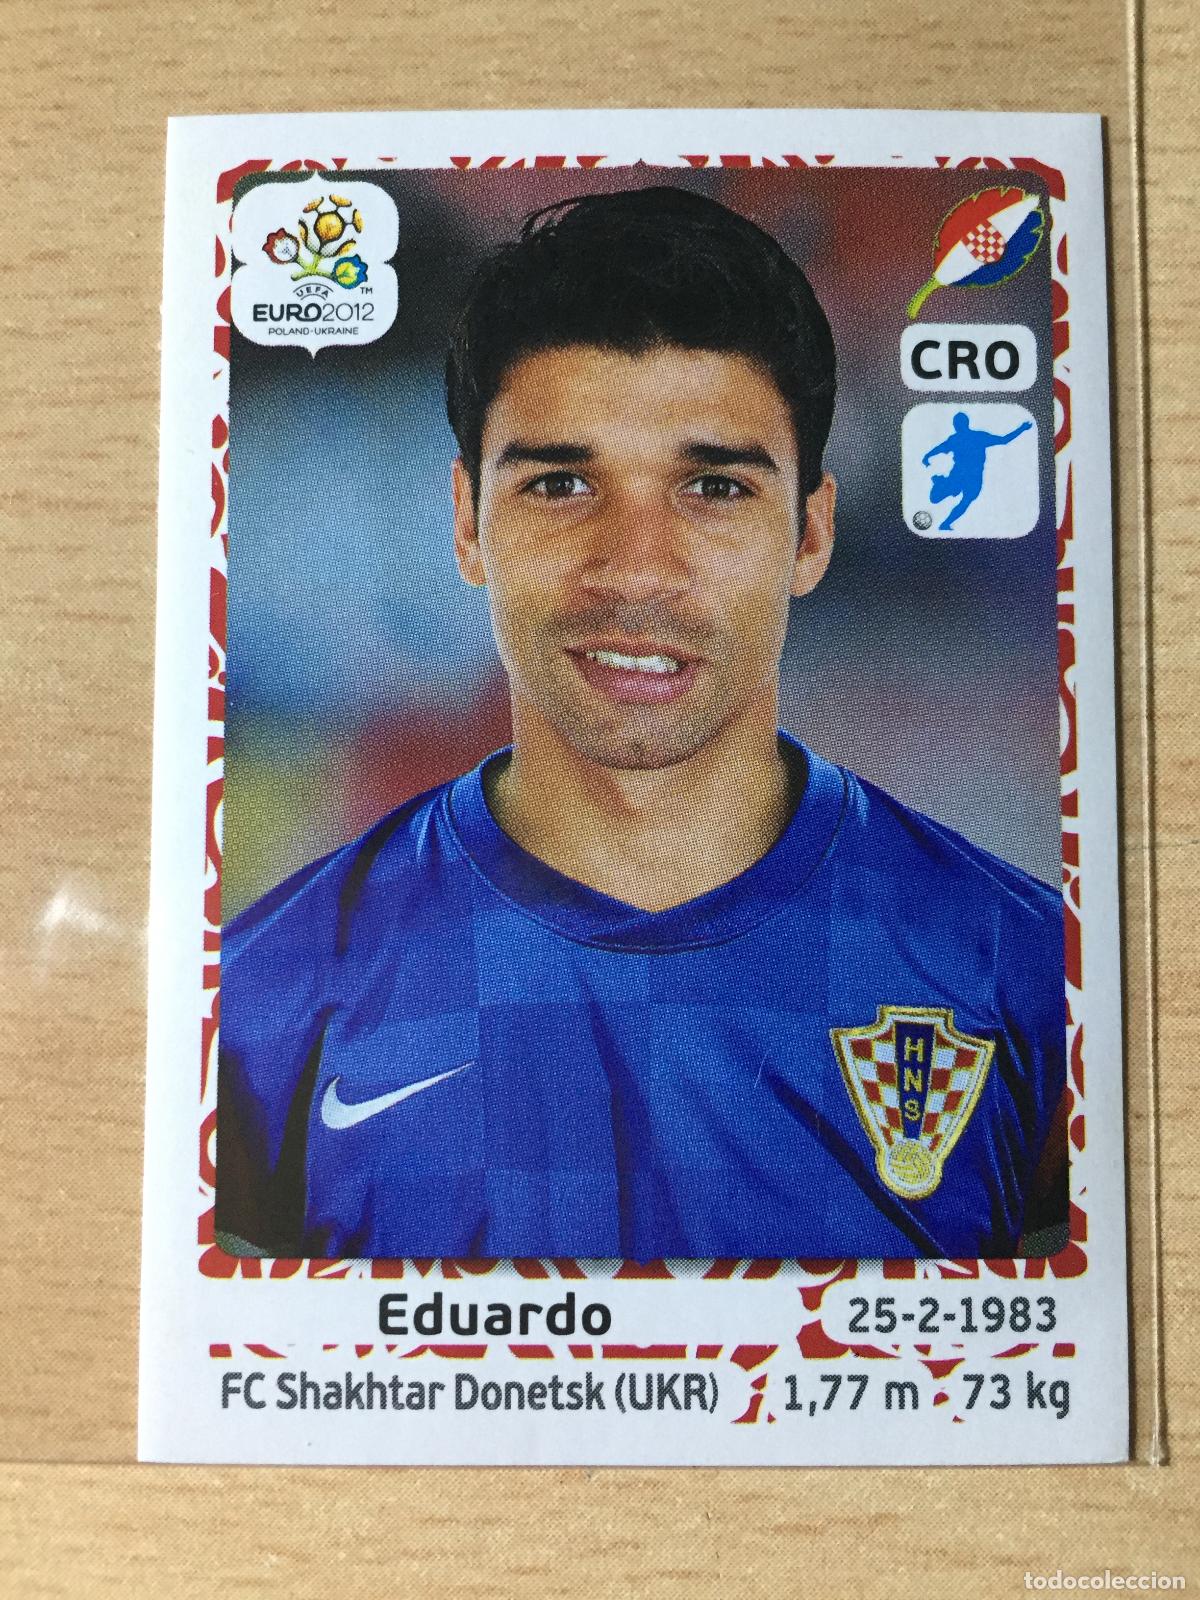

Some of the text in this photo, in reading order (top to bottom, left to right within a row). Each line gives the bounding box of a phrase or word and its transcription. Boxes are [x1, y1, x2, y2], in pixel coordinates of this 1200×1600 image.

[296, 286, 329, 298] UEFA
[360, 287, 373, 295] TM
[911, 339, 1020, 380] CRO
[378, 1291, 612, 1336] Eduardo
[848, 1296, 1057, 1334] 25-2-1983
[221, 1371, 719, 1414] FC Shakhtar Donetsk (UKR)
[784, 1374, 919, 1417] 1,77 m
[962, 1370, 1070, 1420] 73 kg
